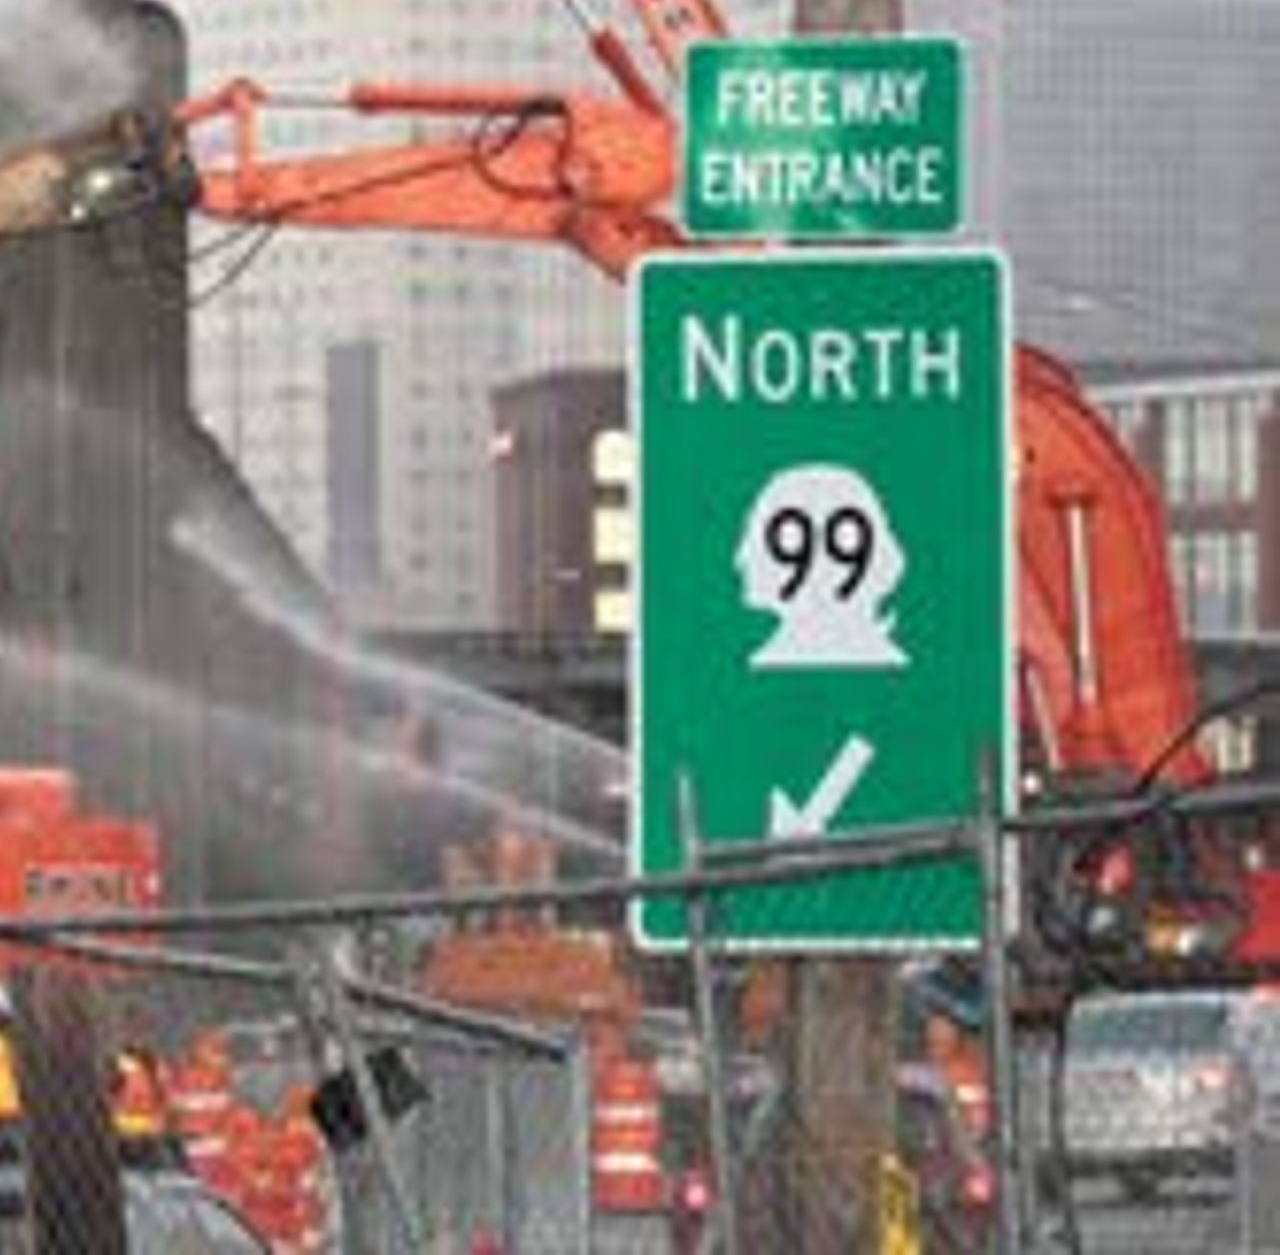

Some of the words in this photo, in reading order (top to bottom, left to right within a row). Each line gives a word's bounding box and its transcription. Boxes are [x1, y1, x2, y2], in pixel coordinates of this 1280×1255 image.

[716, 68, 928, 126] FREEWAY
[701, 148, 944, 204] ENTRANCE
[681, 314, 960, 403] NORTH
[764, 506, 876, 602] 99
